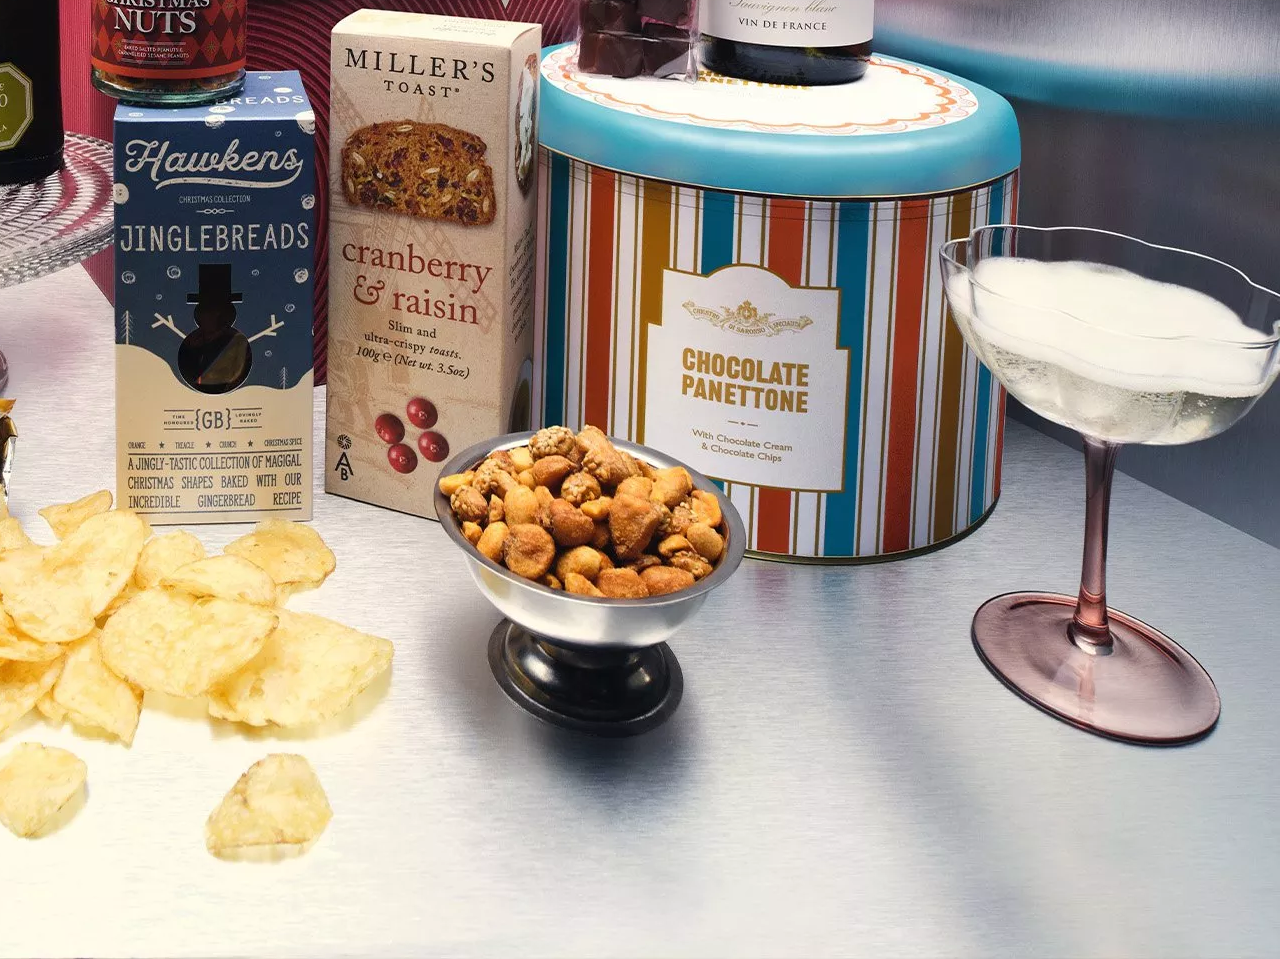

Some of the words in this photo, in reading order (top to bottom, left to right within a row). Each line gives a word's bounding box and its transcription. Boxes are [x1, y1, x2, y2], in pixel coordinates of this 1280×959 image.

[113, 6, 197, 34] NUTS
[738, 17, 753, 27] VIN
[763, 19, 778, 29] DE
[782, 21, 828, 31] FRANCE
[344, 47, 495, 83] MILLER'S
[125, 138, 304, 187] Hawkens
[179, 195, 213, 204] CHRISTMAS
[213, 194, 251, 203] COLLECTION
[120, 222, 309, 252] JINGLEBREADS
[341, 242, 493, 293] cranberry
[353, 274, 386, 305] &
[391, 288, 480, 325] raisin
[388, 319, 413, 335] Slim
[416, 328, 437, 339] and
[364, 331, 426, 354] ultra-crispy
[429, 346, 462, 360] toasts.
[356, 346, 381, 363] 100g
[394, 353, 417, 367] (Net
[419, 361, 434, 371] wt.
[436, 362, 470, 380] 3.5oz)
[681, 347, 810, 388] CHOCOLATE
[681, 373, 809, 414] PANETTONE
[127, 441, 147, 450] ORANGE
[264, 438, 290, 447] CHRISTMAS
[692, 428, 714, 441] With
[716, 434, 761, 449] Chocolate
[763, 441, 793, 452] Cream
[701, 442, 708, 451] &
[710, 444, 755, 459] Chocolate
[757, 452, 782, 464] Chips
[127, 457, 134, 471] A
[135, 457, 198, 471] JINGLY-TASTIC
[199, 455, 251, 471] COLLECTION
[252, 455, 264, 469] OF
[127, 476, 175, 490] CHRISTMAS
[181, 475, 214, 489] SHAPES
[221, 474, 249, 488] BAKED
[256, 473, 277, 487] WITH
[284, 472, 302, 486] OUR
[128, 495, 181, 509] INCREDIBLE
[197, 494, 256, 508] GINGERBREAD
[273, 491, 302, 506] RECIPE
